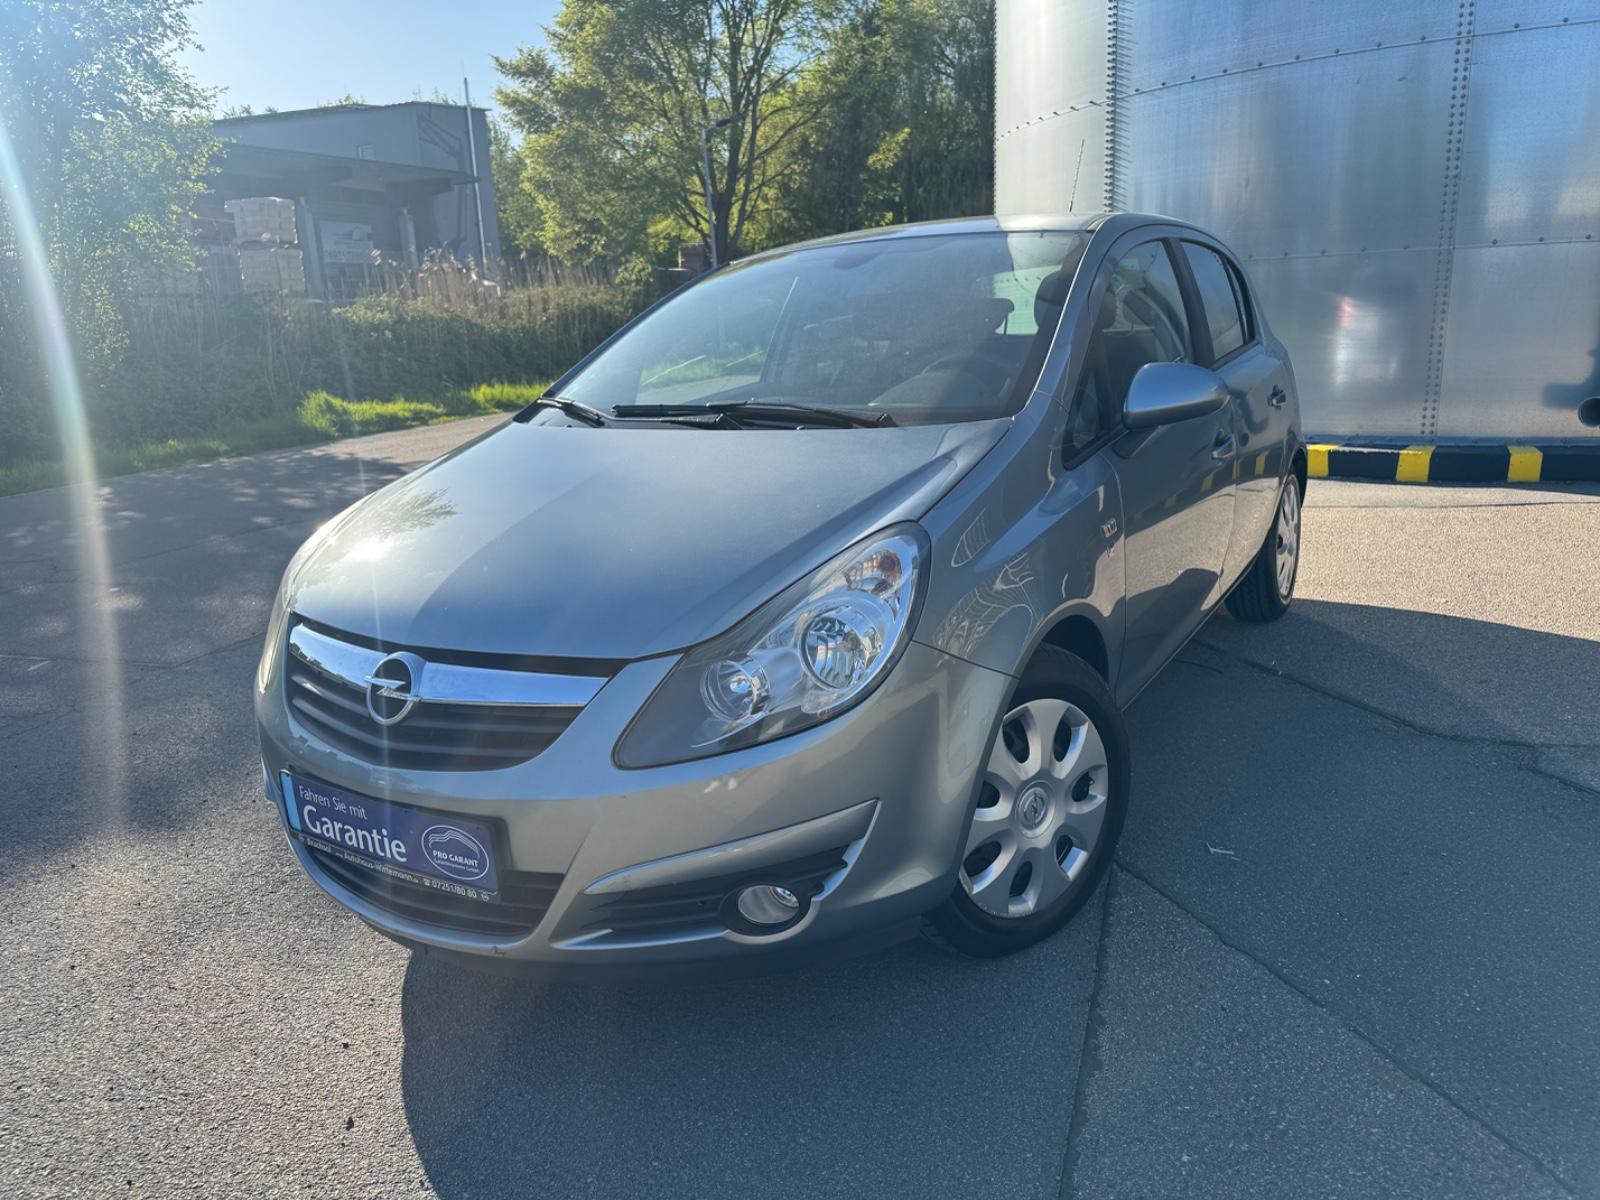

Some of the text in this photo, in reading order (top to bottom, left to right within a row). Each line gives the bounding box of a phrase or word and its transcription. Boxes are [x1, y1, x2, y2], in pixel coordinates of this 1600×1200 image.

[299, 785, 368, 820] Fahren Sie mit
[303, 804, 408, 862] Garantie
[432, 849, 448, 861] PRO
[448, 853, 479, 868] GARANT
[431, 879, 466, 896] 07251/80
